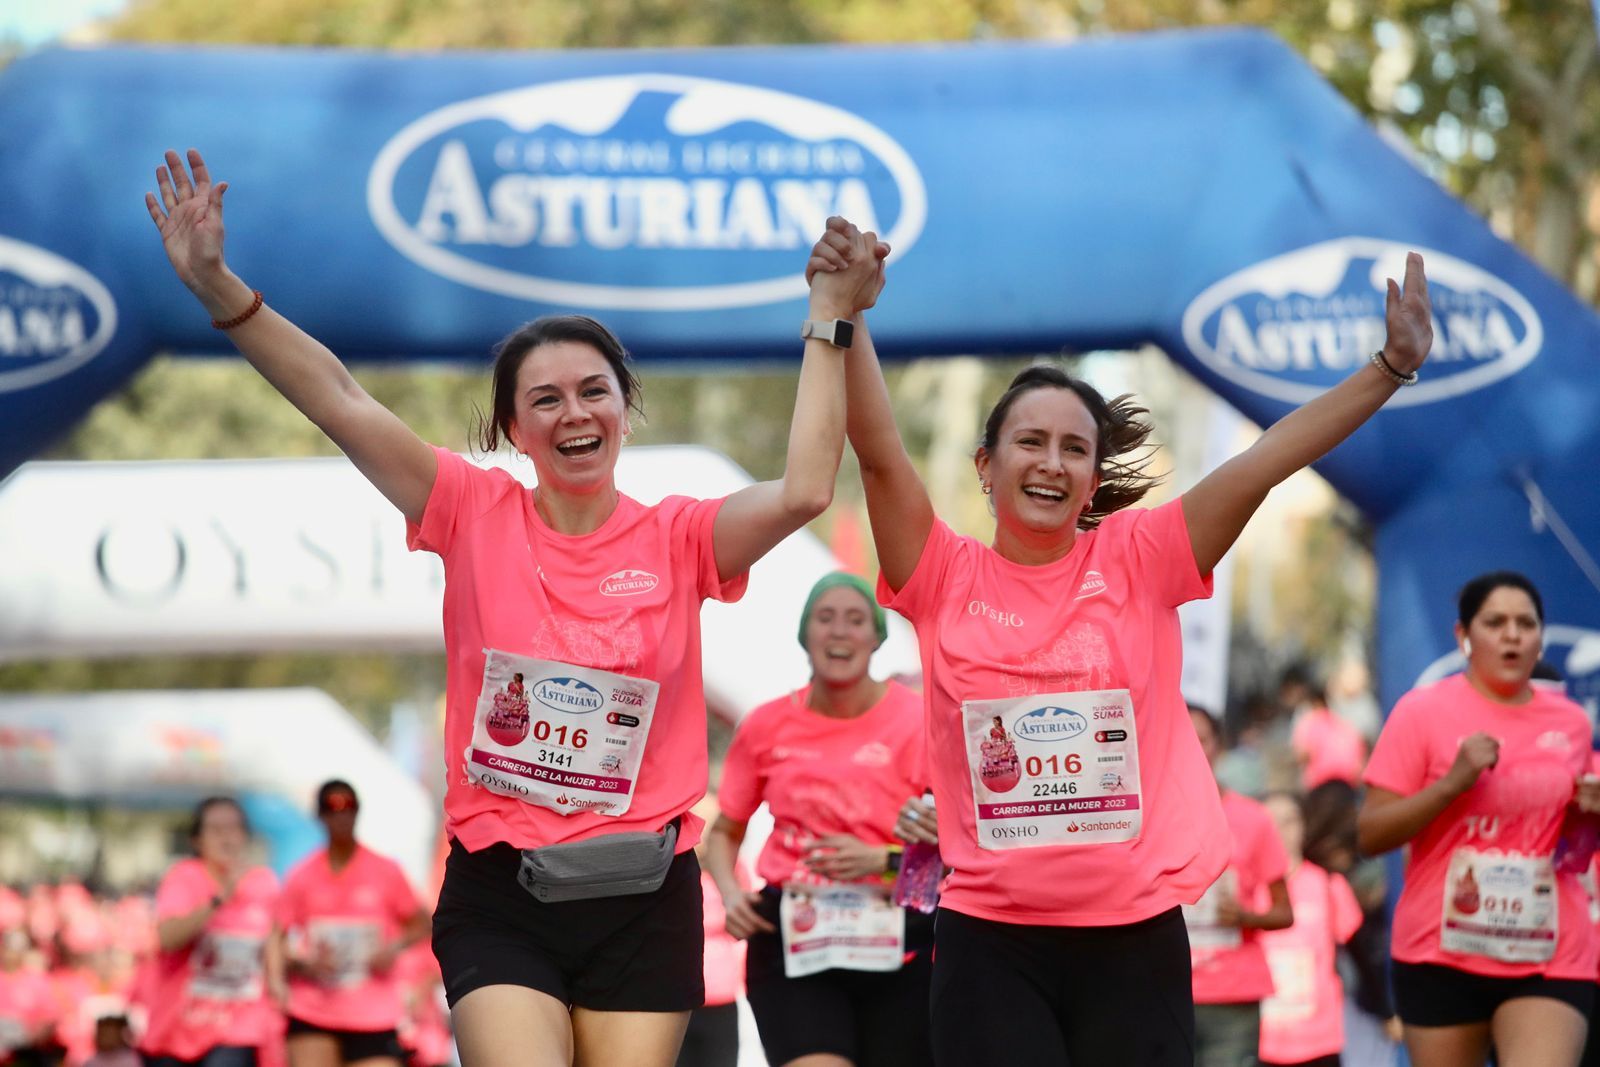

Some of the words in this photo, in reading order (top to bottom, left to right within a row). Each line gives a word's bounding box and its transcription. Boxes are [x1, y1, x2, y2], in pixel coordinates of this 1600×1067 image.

[414, 140, 880, 249] ASTURIANA
[605, 579, 656, 594] ASTURIANA
[968, 600, 1024, 628] OYSHO
[537, 684, 598, 708] ASTURIANA
[611, 693, 643, 706] SUMA
[1093, 710, 1124, 720] SUMA
[533, 720, 588, 749] 016
[1019, 721, 1082, 735] ASTURIANA
[537, 749, 573, 768] 3141
[1025, 753, 1082, 777] 016
[488, 757, 532, 775] CARRERA
[533, 768, 548, 779] DE
[549, 772, 562, 782] LA
[563, 775, 596, 787] MUJER
[598, 780, 619, 790] 2023
[481, 773, 529, 796] OYSHO
[1032, 781, 1077, 797] 22446
[992, 807, 1036, 816] CARRERA
[1038, 804, 1052, 813] DE
[1053, 803, 1067, 811] LA
[1068, 800, 1101, 810] MUJER
[1104, 798, 1127, 808] 2023
[991, 825, 1039, 839] OYSHO
[1080, 820, 1132, 832] Santander
